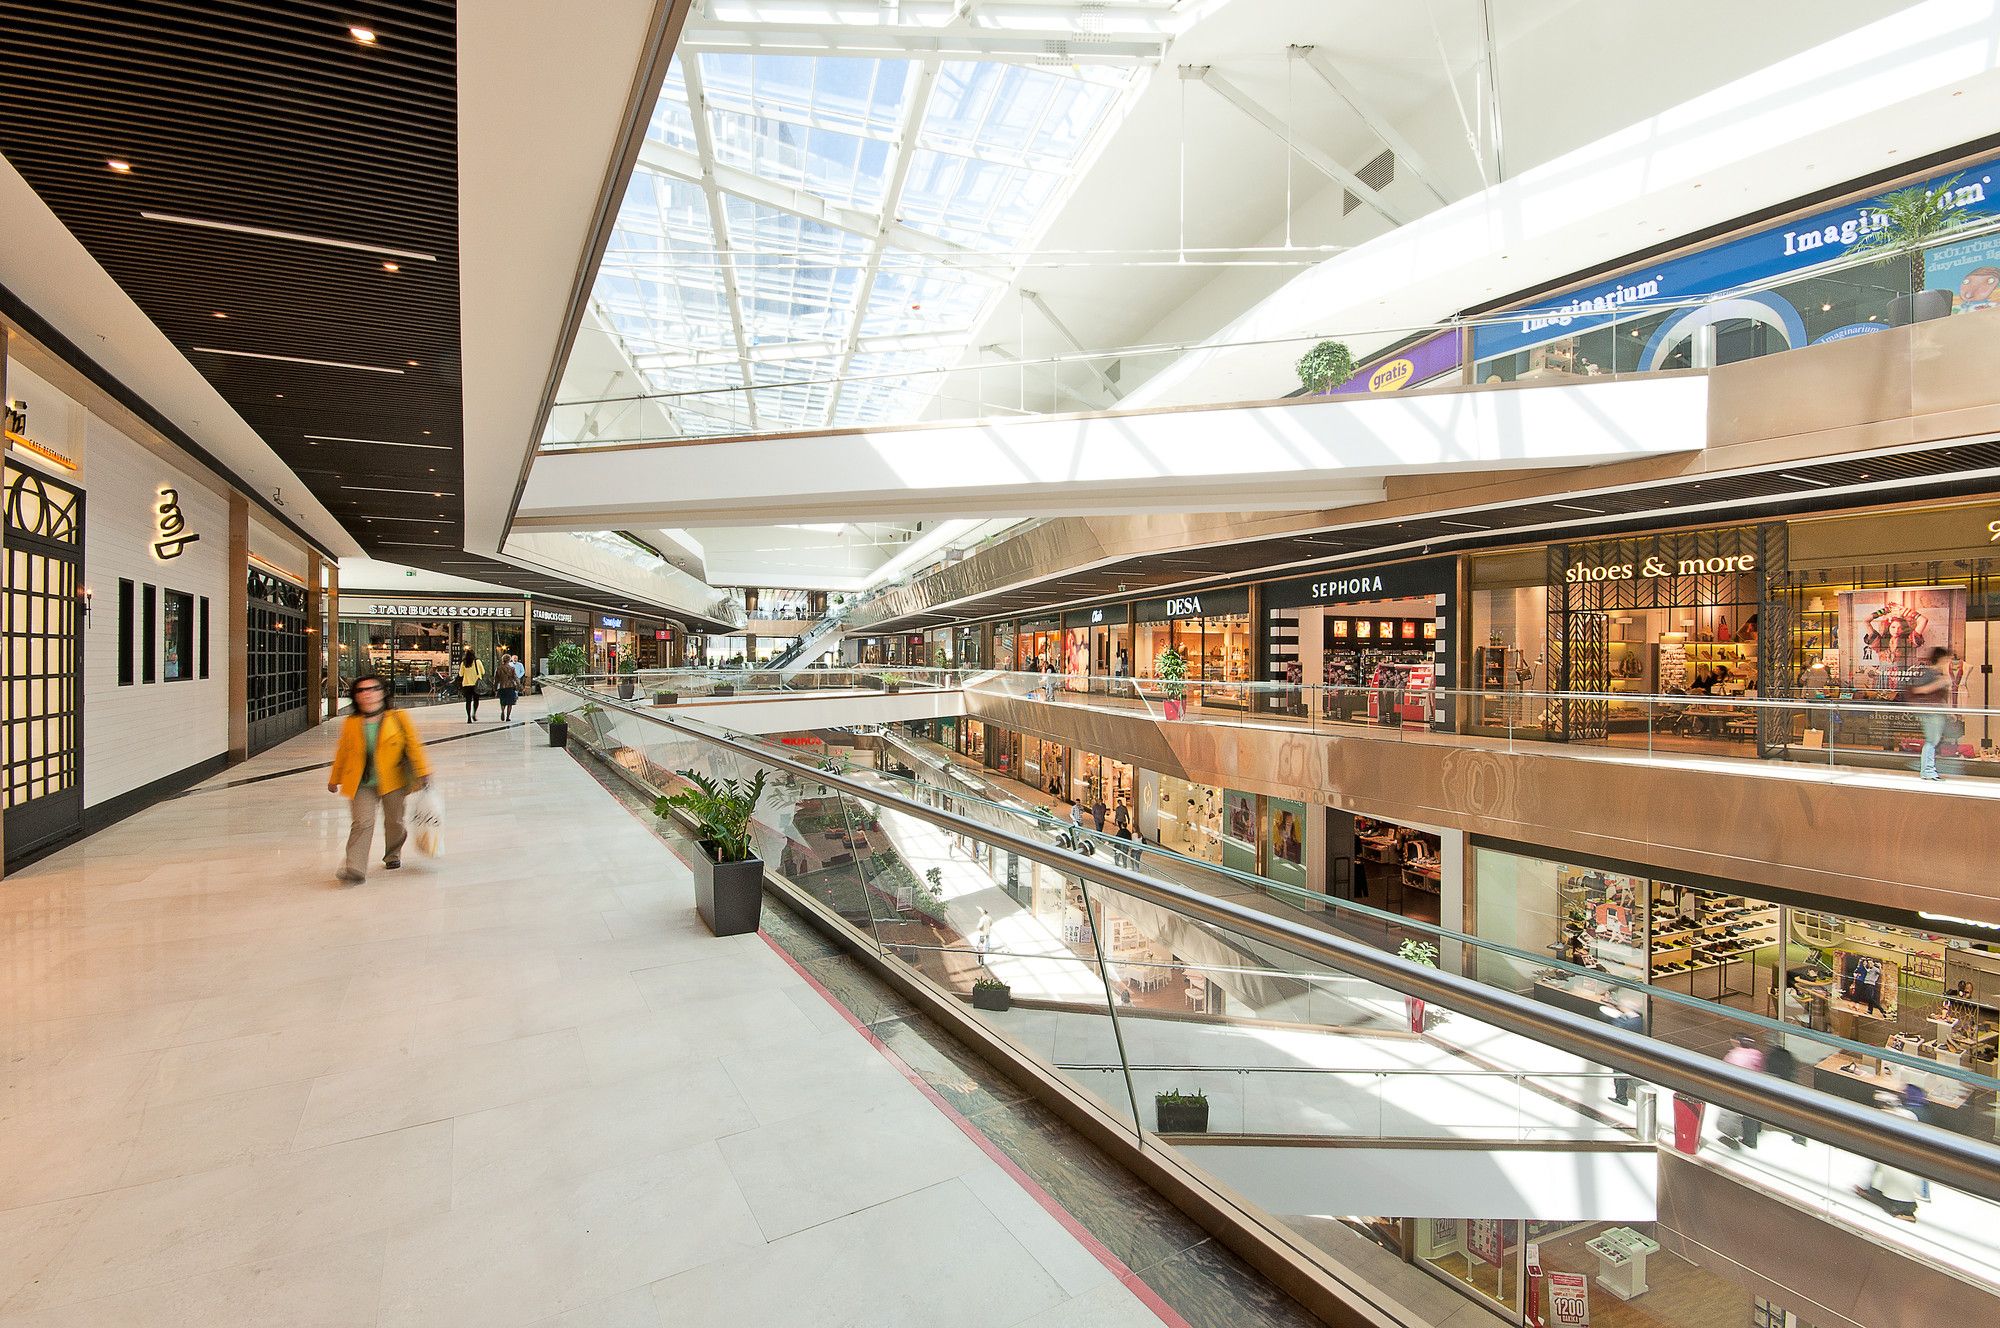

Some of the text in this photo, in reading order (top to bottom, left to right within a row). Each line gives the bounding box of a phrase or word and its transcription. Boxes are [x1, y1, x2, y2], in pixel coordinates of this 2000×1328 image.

[1928, 254, 1984, 273] duyulan
[1821, 324, 1880, 344] Imaginarium
[1373, 362, 1408, 391] gratis
[1565, 553, 1755, 583] shoes & more
[1312, 575, 1383, 599] SEPHORA
[368, 605, 512, 617] STARBUCKS COFFEE
[532, 609, 573, 623] STARBUCKS COFFEE
[1166, 596, 1202, 616] DESA
[1555, 1297, 1584, 1318] 1200
